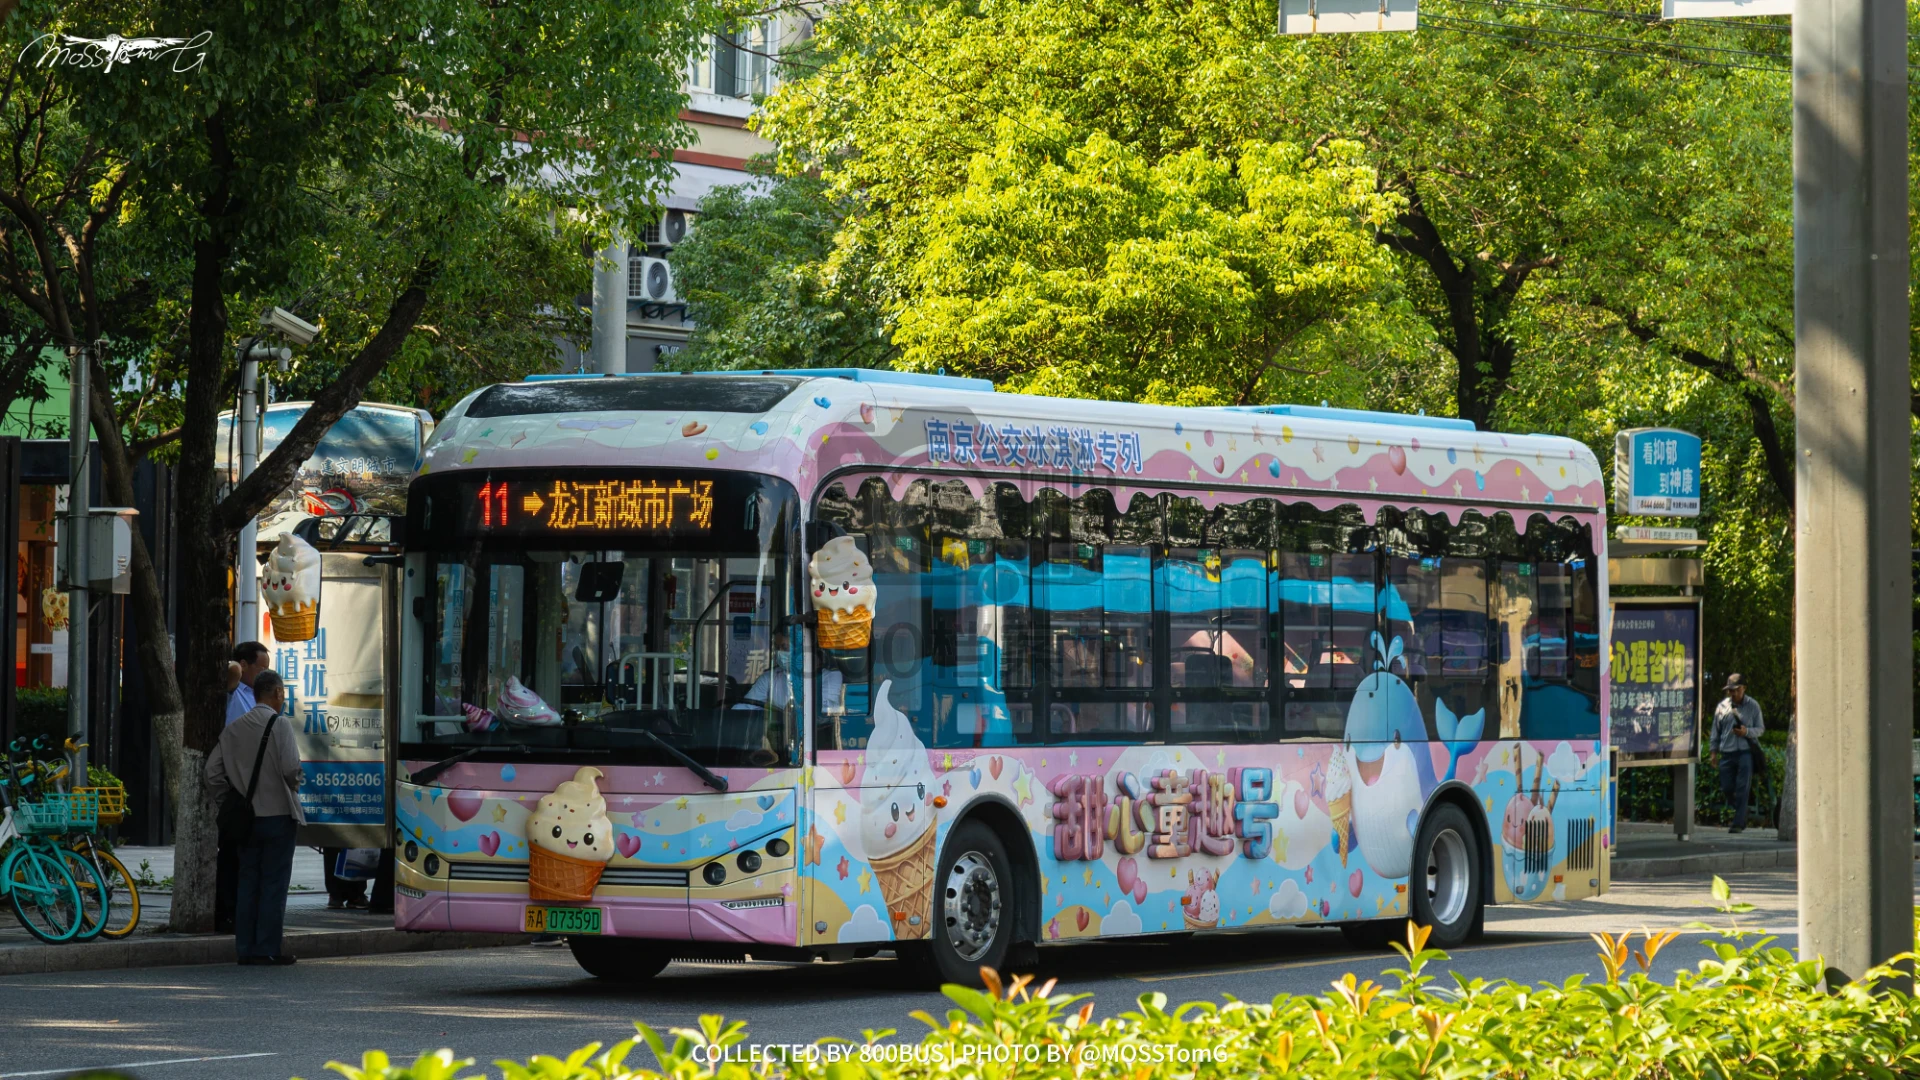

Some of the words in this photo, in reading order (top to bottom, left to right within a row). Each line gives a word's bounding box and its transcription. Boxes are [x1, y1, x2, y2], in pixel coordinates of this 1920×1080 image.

[925, 417, 1143, 475] 南京公交冰淇淋专列
[1643, 438, 1677, 465] 看抑郁
[1659, 467, 1693, 494] 到神康
[478, 481, 507, 526] 11
[547, 479, 713, 529] 龙江新城市广场
[1636, 529, 1650, 540] TAXI
[1611, 639, 1686, 683] 心理咨询
[342, 717, 381, 729] 优禾口腔
[1052, 767, 1279, 861] 甜心童趣号
